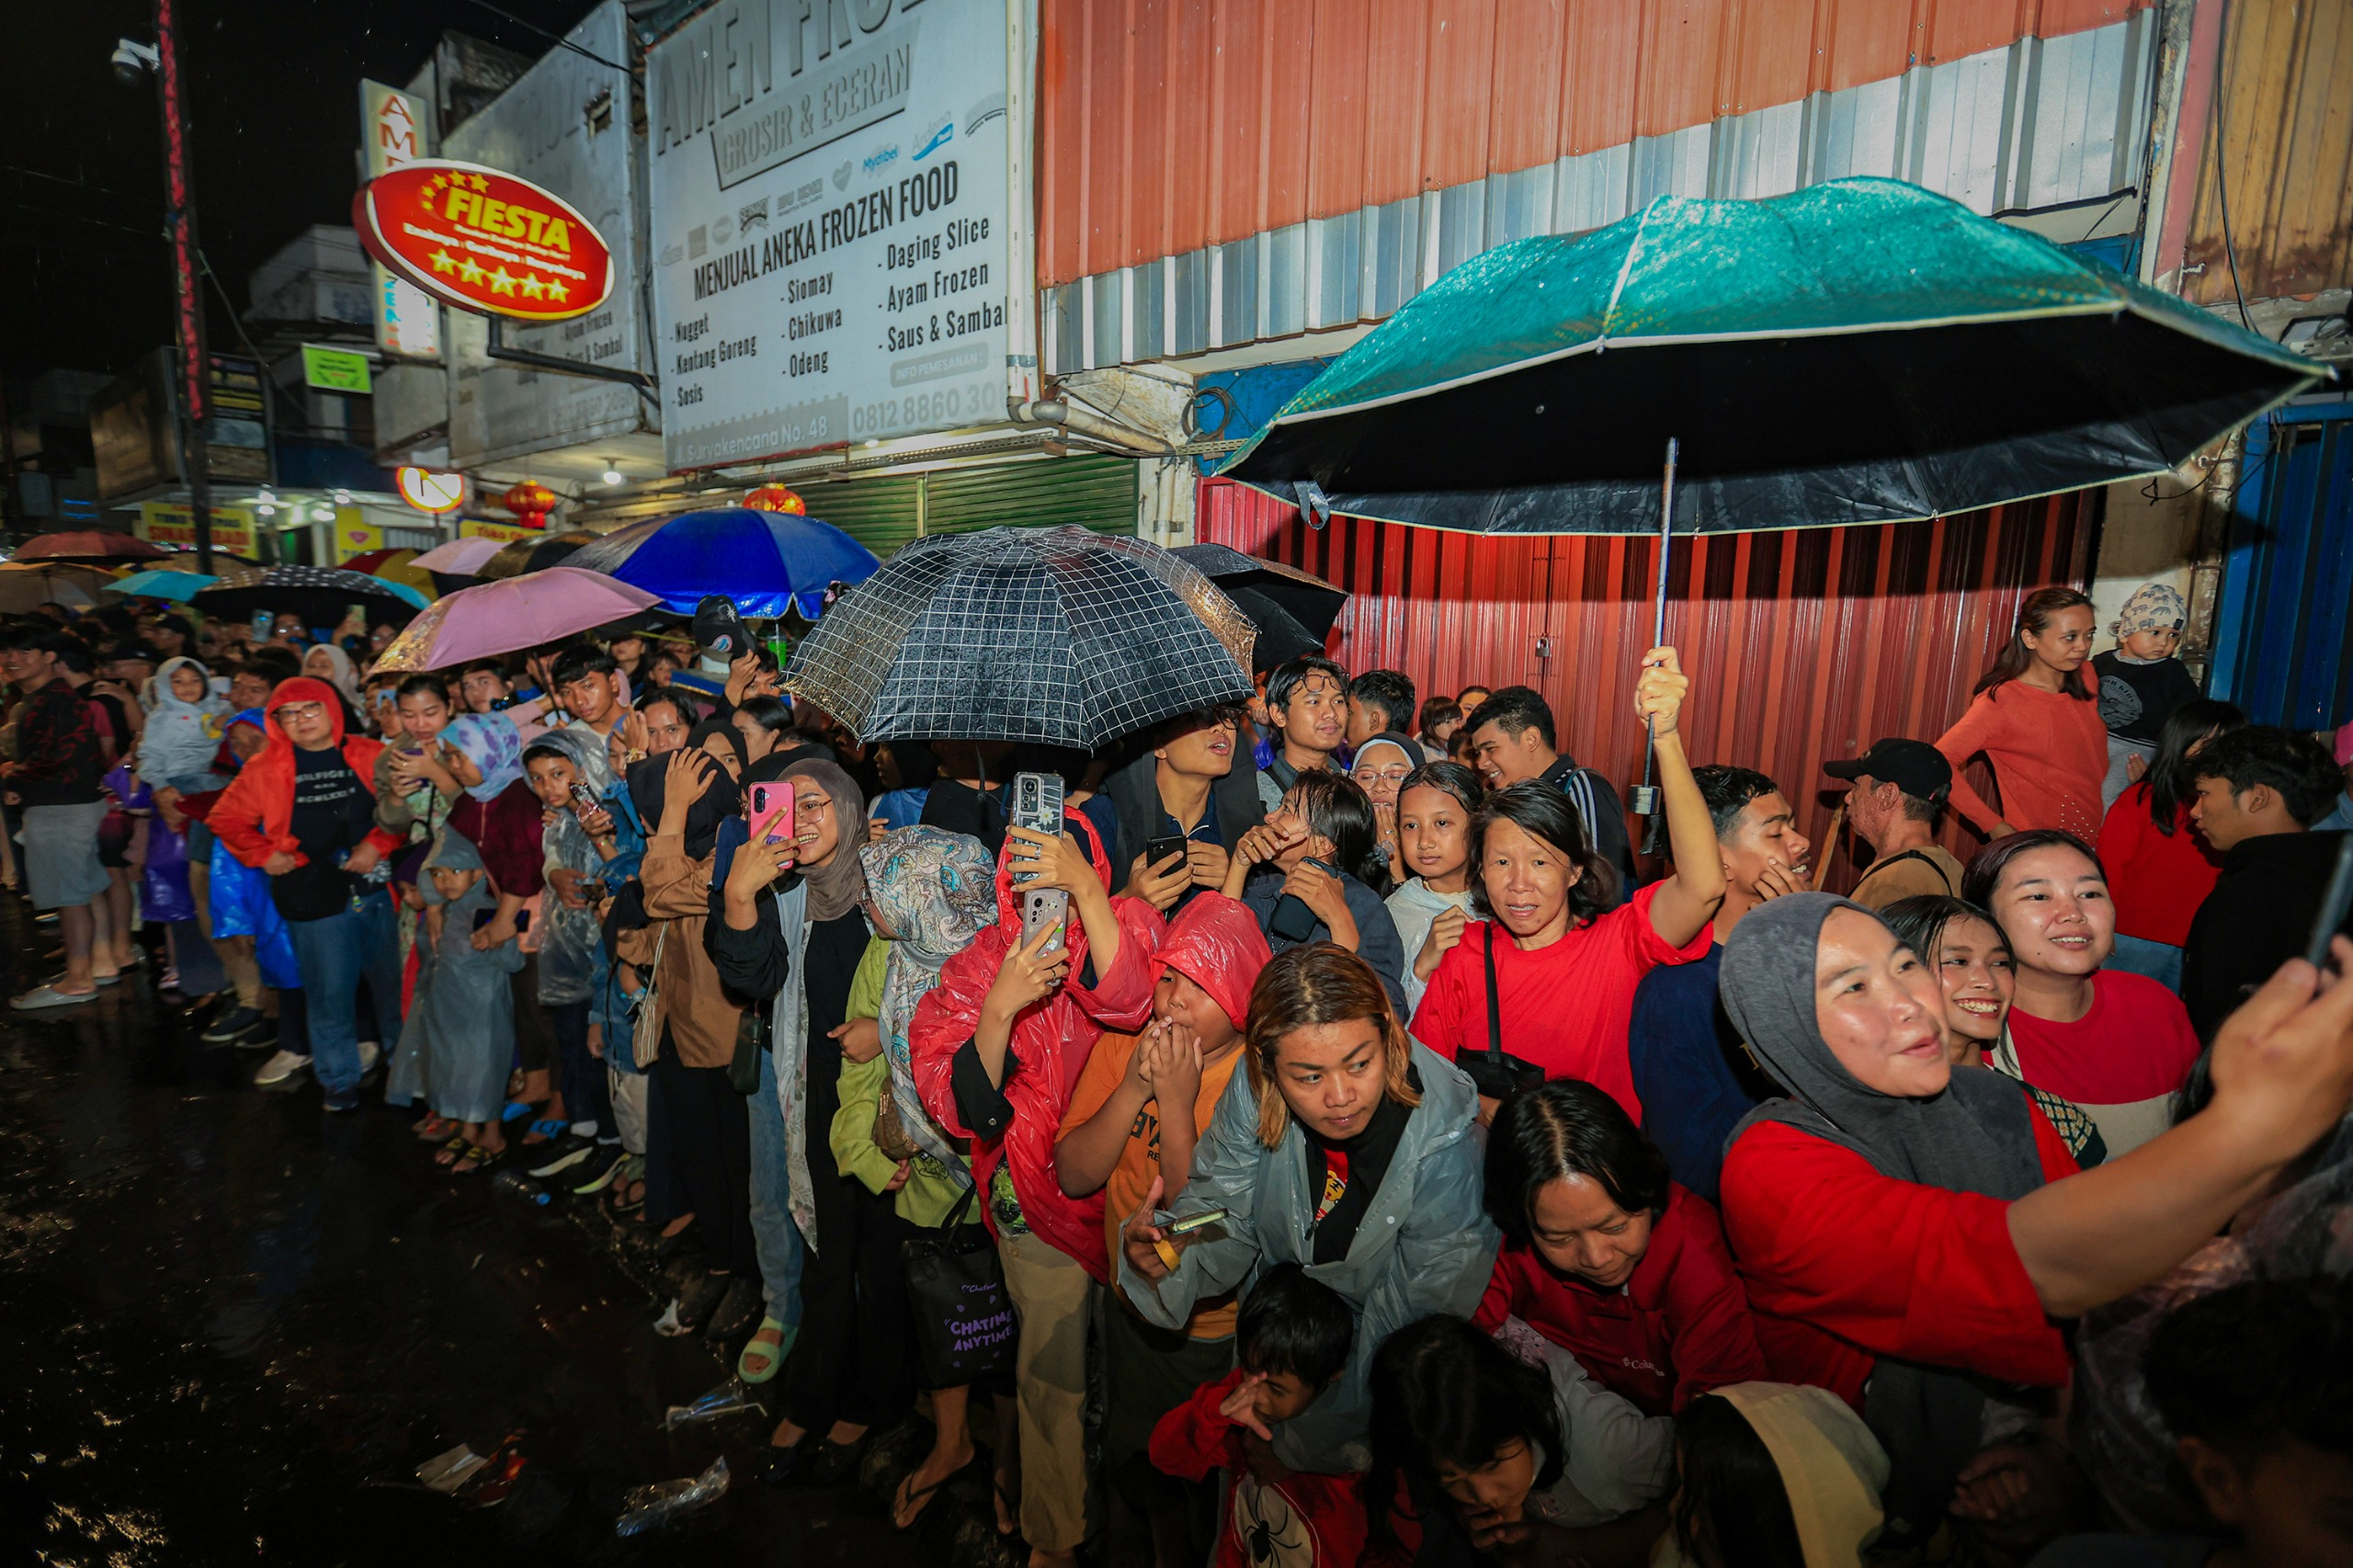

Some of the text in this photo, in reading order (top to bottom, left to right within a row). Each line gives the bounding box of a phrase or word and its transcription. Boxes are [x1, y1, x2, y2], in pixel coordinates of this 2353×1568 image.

[722, 104, 793, 174] GROSIR
[821, 43, 911, 130] ECERAN
[444, 186, 572, 254] FIESTA
[694, 244, 758, 301] MENJUAL
[762, 219, 817, 275] ANEKA
[821, 186, 893, 253] FROZEN
[899, 160, 959, 223] FOOD
[887, 218, 989, 270] Daging Slice
[788, 272, 834, 304] Siomay
[887, 263, 988, 313] Ayam Frozen
[675, 312, 710, 343] Nugget
[789, 308, 843, 341] Chikuwa
[888, 295, 1007, 352] Saus & Sambal
[676, 335, 757, 375] Kentang Goreng
[790, 350, 829, 378] Odeng
[853, 400, 898, 434] 0812
[903, 388, 961, 426] 8860
[688, 430, 779, 460] Suryakencana
[781, 423, 805, 444] No.
[808, 415, 827, 438] 48
